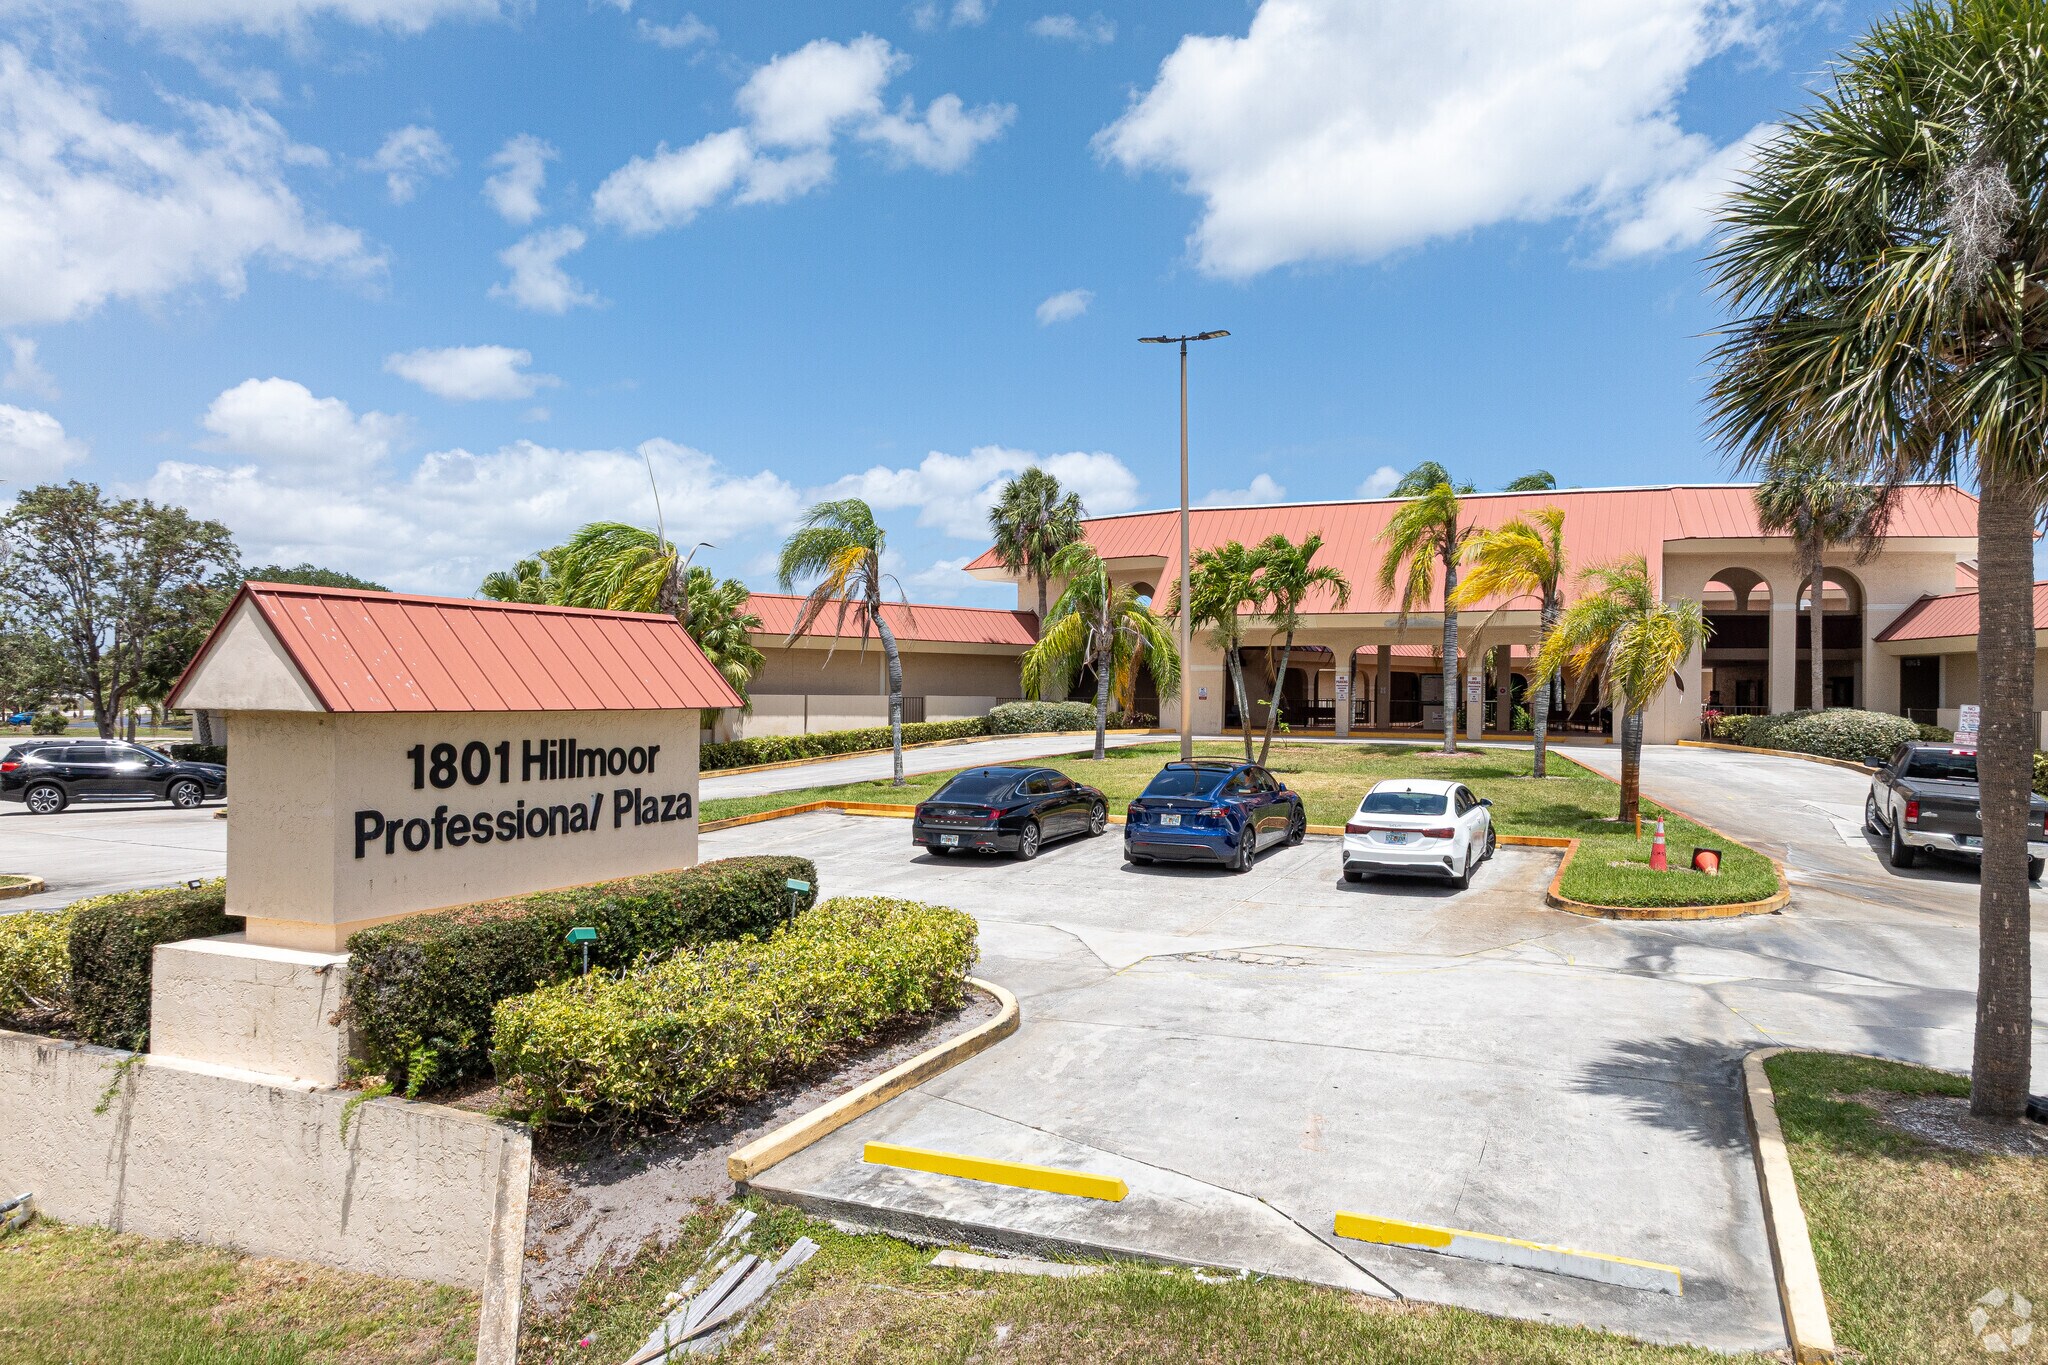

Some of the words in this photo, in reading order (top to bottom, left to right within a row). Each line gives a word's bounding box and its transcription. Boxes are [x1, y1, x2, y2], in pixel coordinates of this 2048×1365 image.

[407, 740, 510, 790] 1801
[522, 738, 661, 782] Hillmoor
[355, 792, 605, 859] Professional
[614, 787, 693, 828] Plaza
